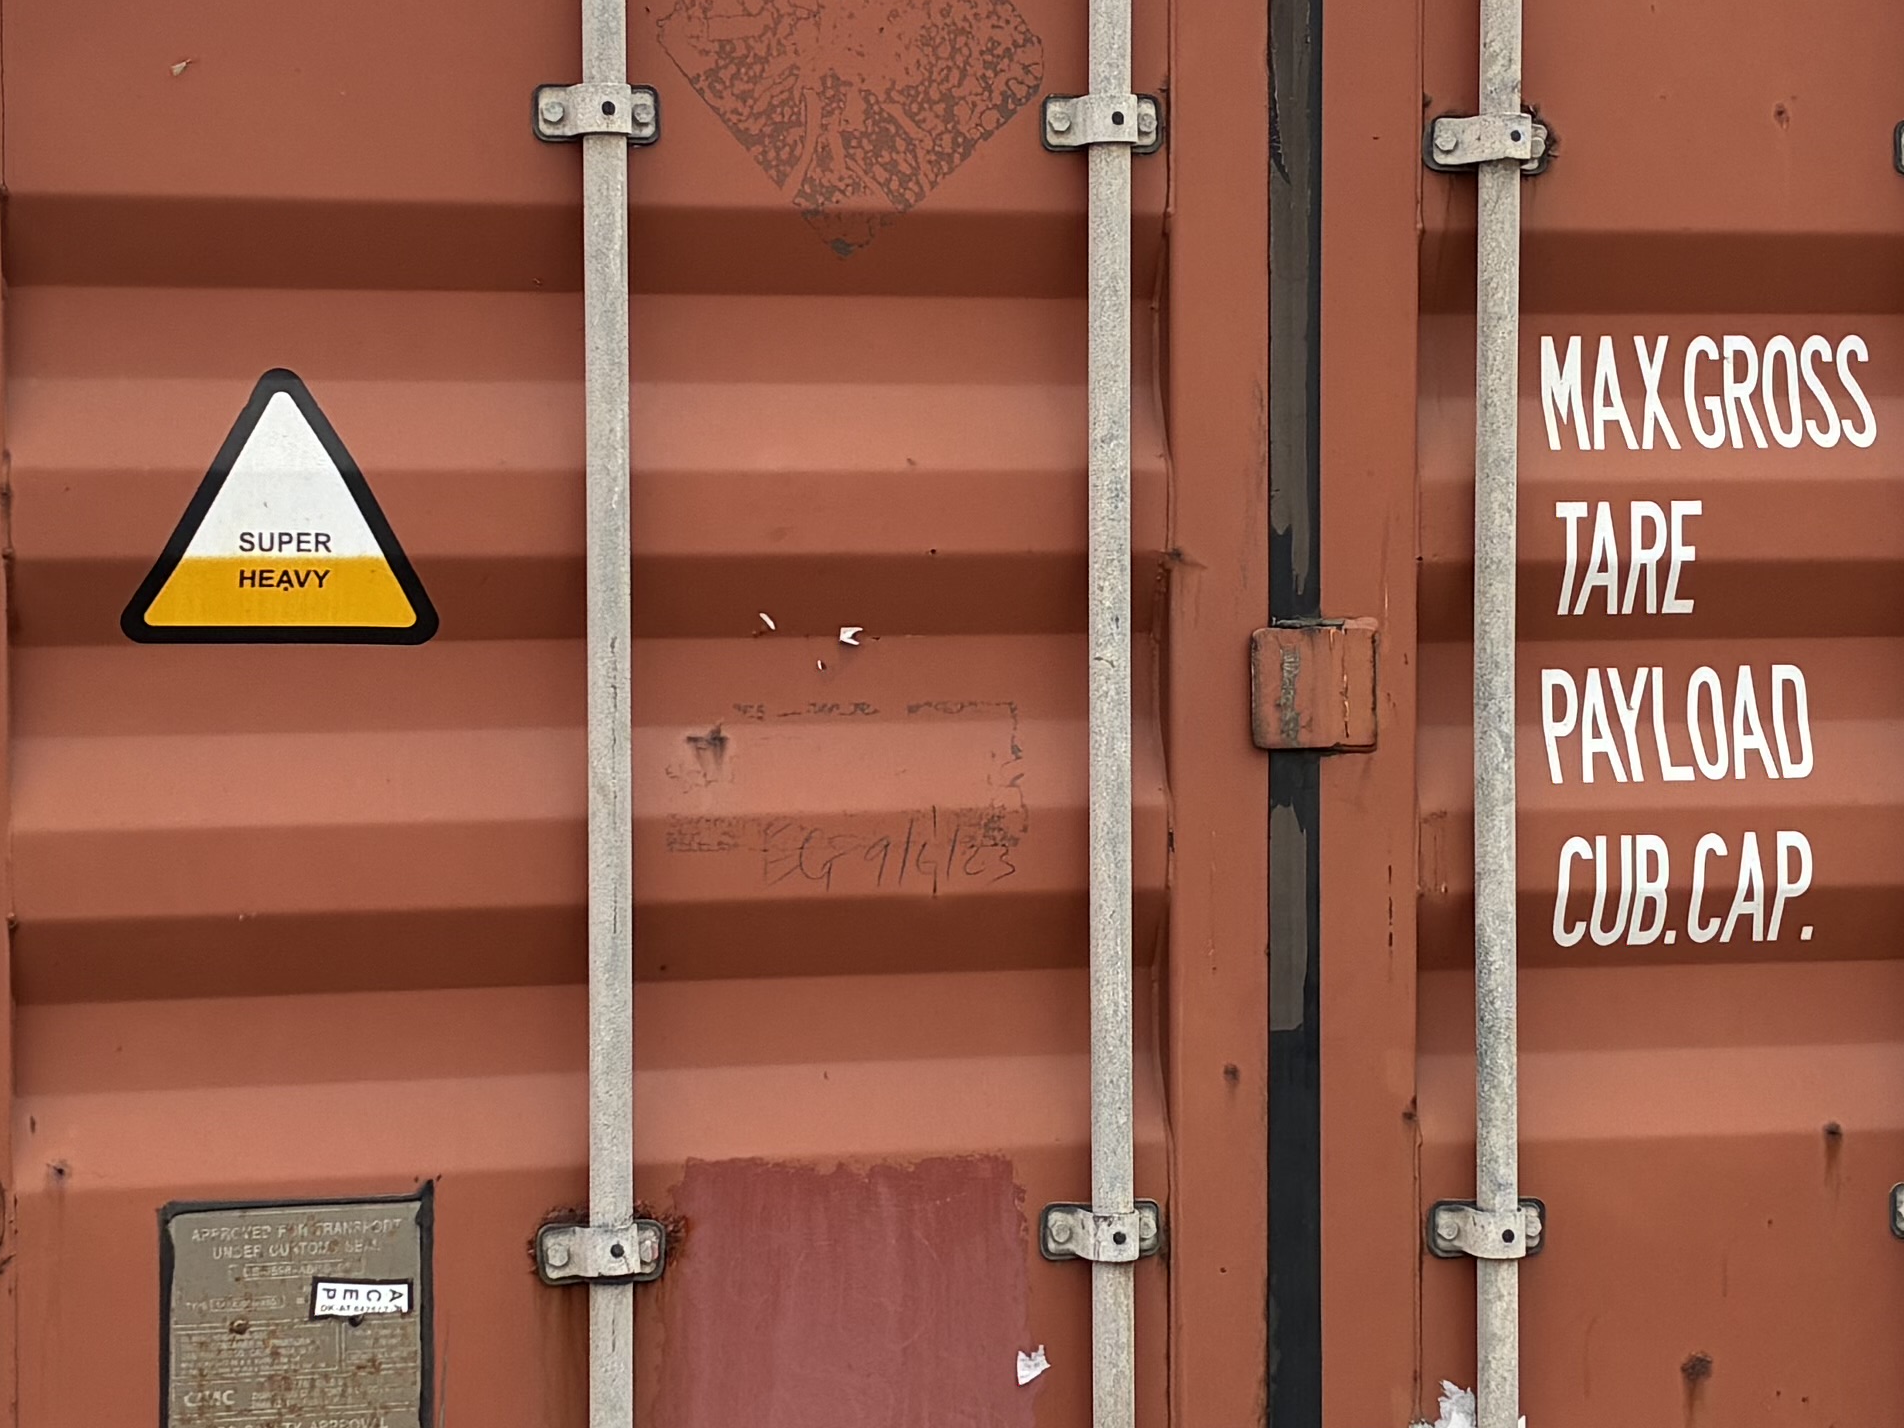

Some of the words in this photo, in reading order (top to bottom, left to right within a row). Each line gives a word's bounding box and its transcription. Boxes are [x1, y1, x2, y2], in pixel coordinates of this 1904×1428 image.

[1540, 335, 1681, 451] MAX
[1684, 334, 1878, 450] GROSS
[238, 532, 332, 553] SUPER
[238, 569, 331, 589] HEAVY
[1556, 501, 1702, 615] TARE
[1542, 665, 1813, 784] PAYLOAD
